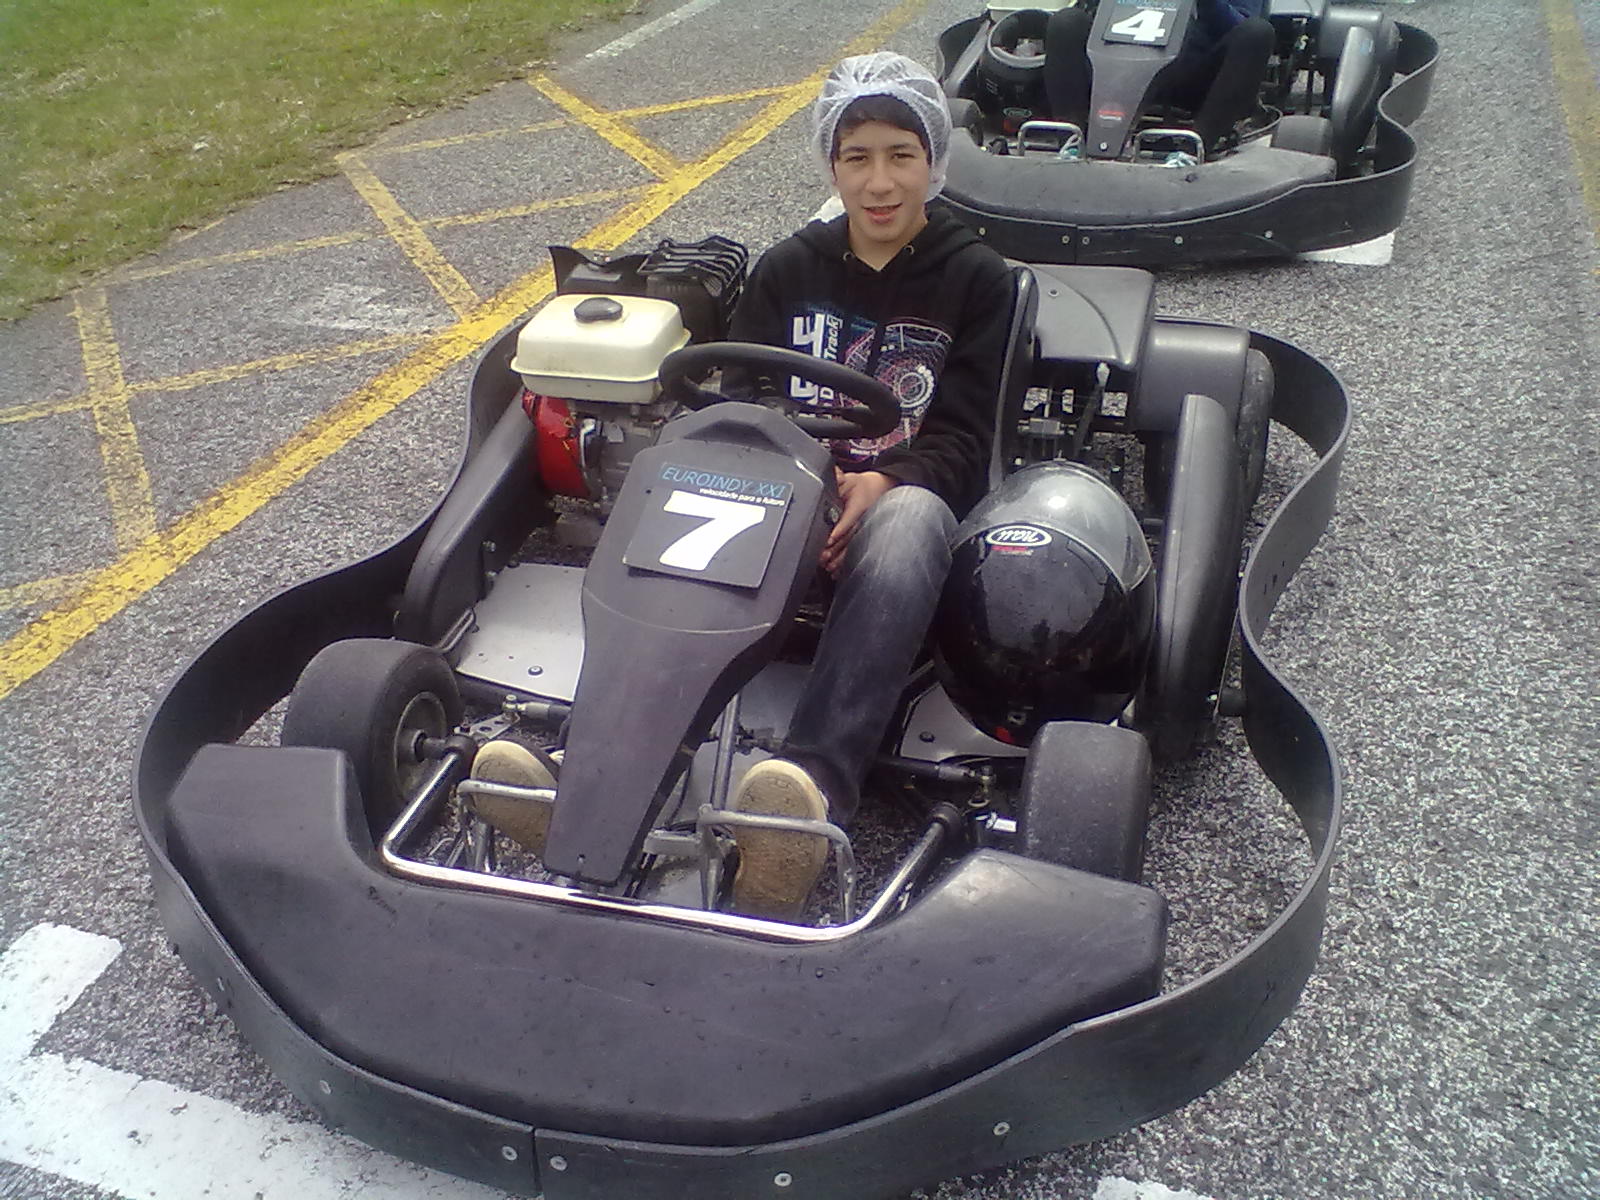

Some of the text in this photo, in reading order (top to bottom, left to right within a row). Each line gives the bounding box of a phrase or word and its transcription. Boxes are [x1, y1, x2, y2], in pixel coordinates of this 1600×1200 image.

[1112, 10, 1165, 41] 4
[662, 467, 787, 498] EUROINDY XXI
[659, 490, 766, 571] 7
